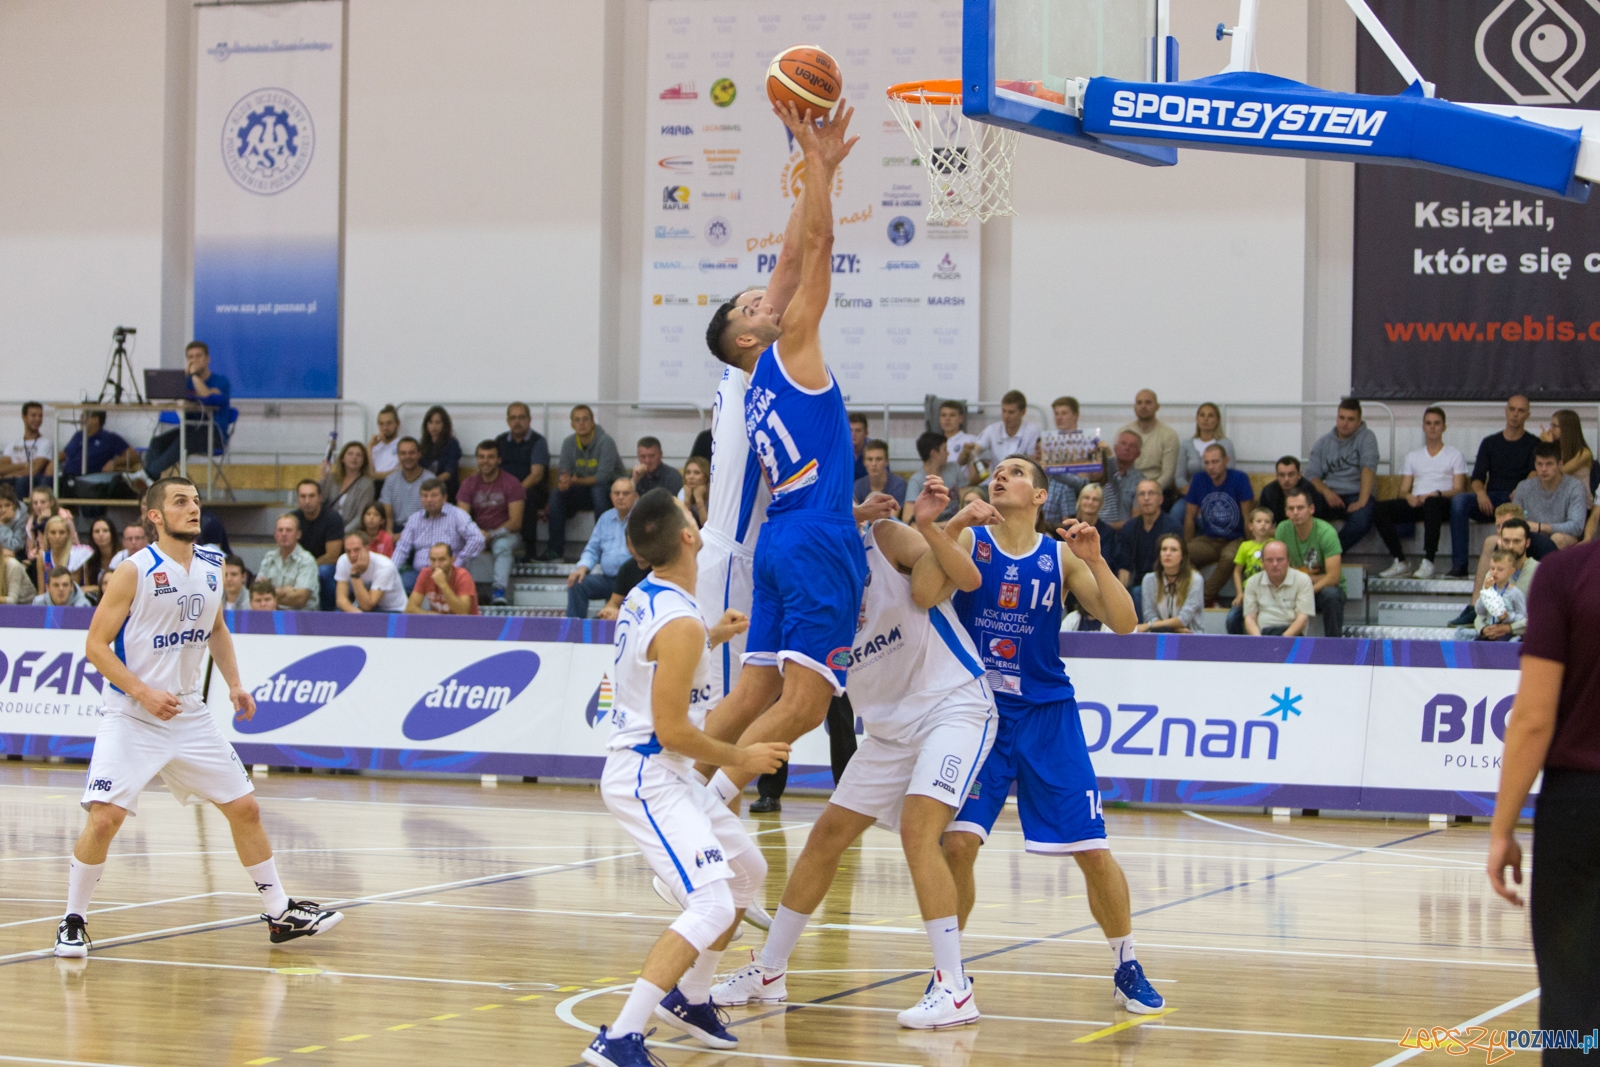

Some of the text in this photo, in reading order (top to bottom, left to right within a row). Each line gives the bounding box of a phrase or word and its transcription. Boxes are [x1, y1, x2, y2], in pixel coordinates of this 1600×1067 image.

[795, 66, 834, 94] molten
[1111, 90, 1388, 137] SPORTSYSTEM
[1414, 200, 1555, 234] Książki,
[1413, 248, 1508, 275] które
[1519, 247, 1572, 280] się
[835, 296, 873, 308] forma
[927, 296, 965, 306] MARSH
[177, 593, 205, 622] 10
[1030, 578, 1056, 612] 14
[983, 608, 1030, 624] KSK NOTEĆ
[255, 673, 338, 704] atrem
[425, 679, 511, 710] atrem
[940, 754, 962, 784] 6
[92, 779, 113, 792] PBG
